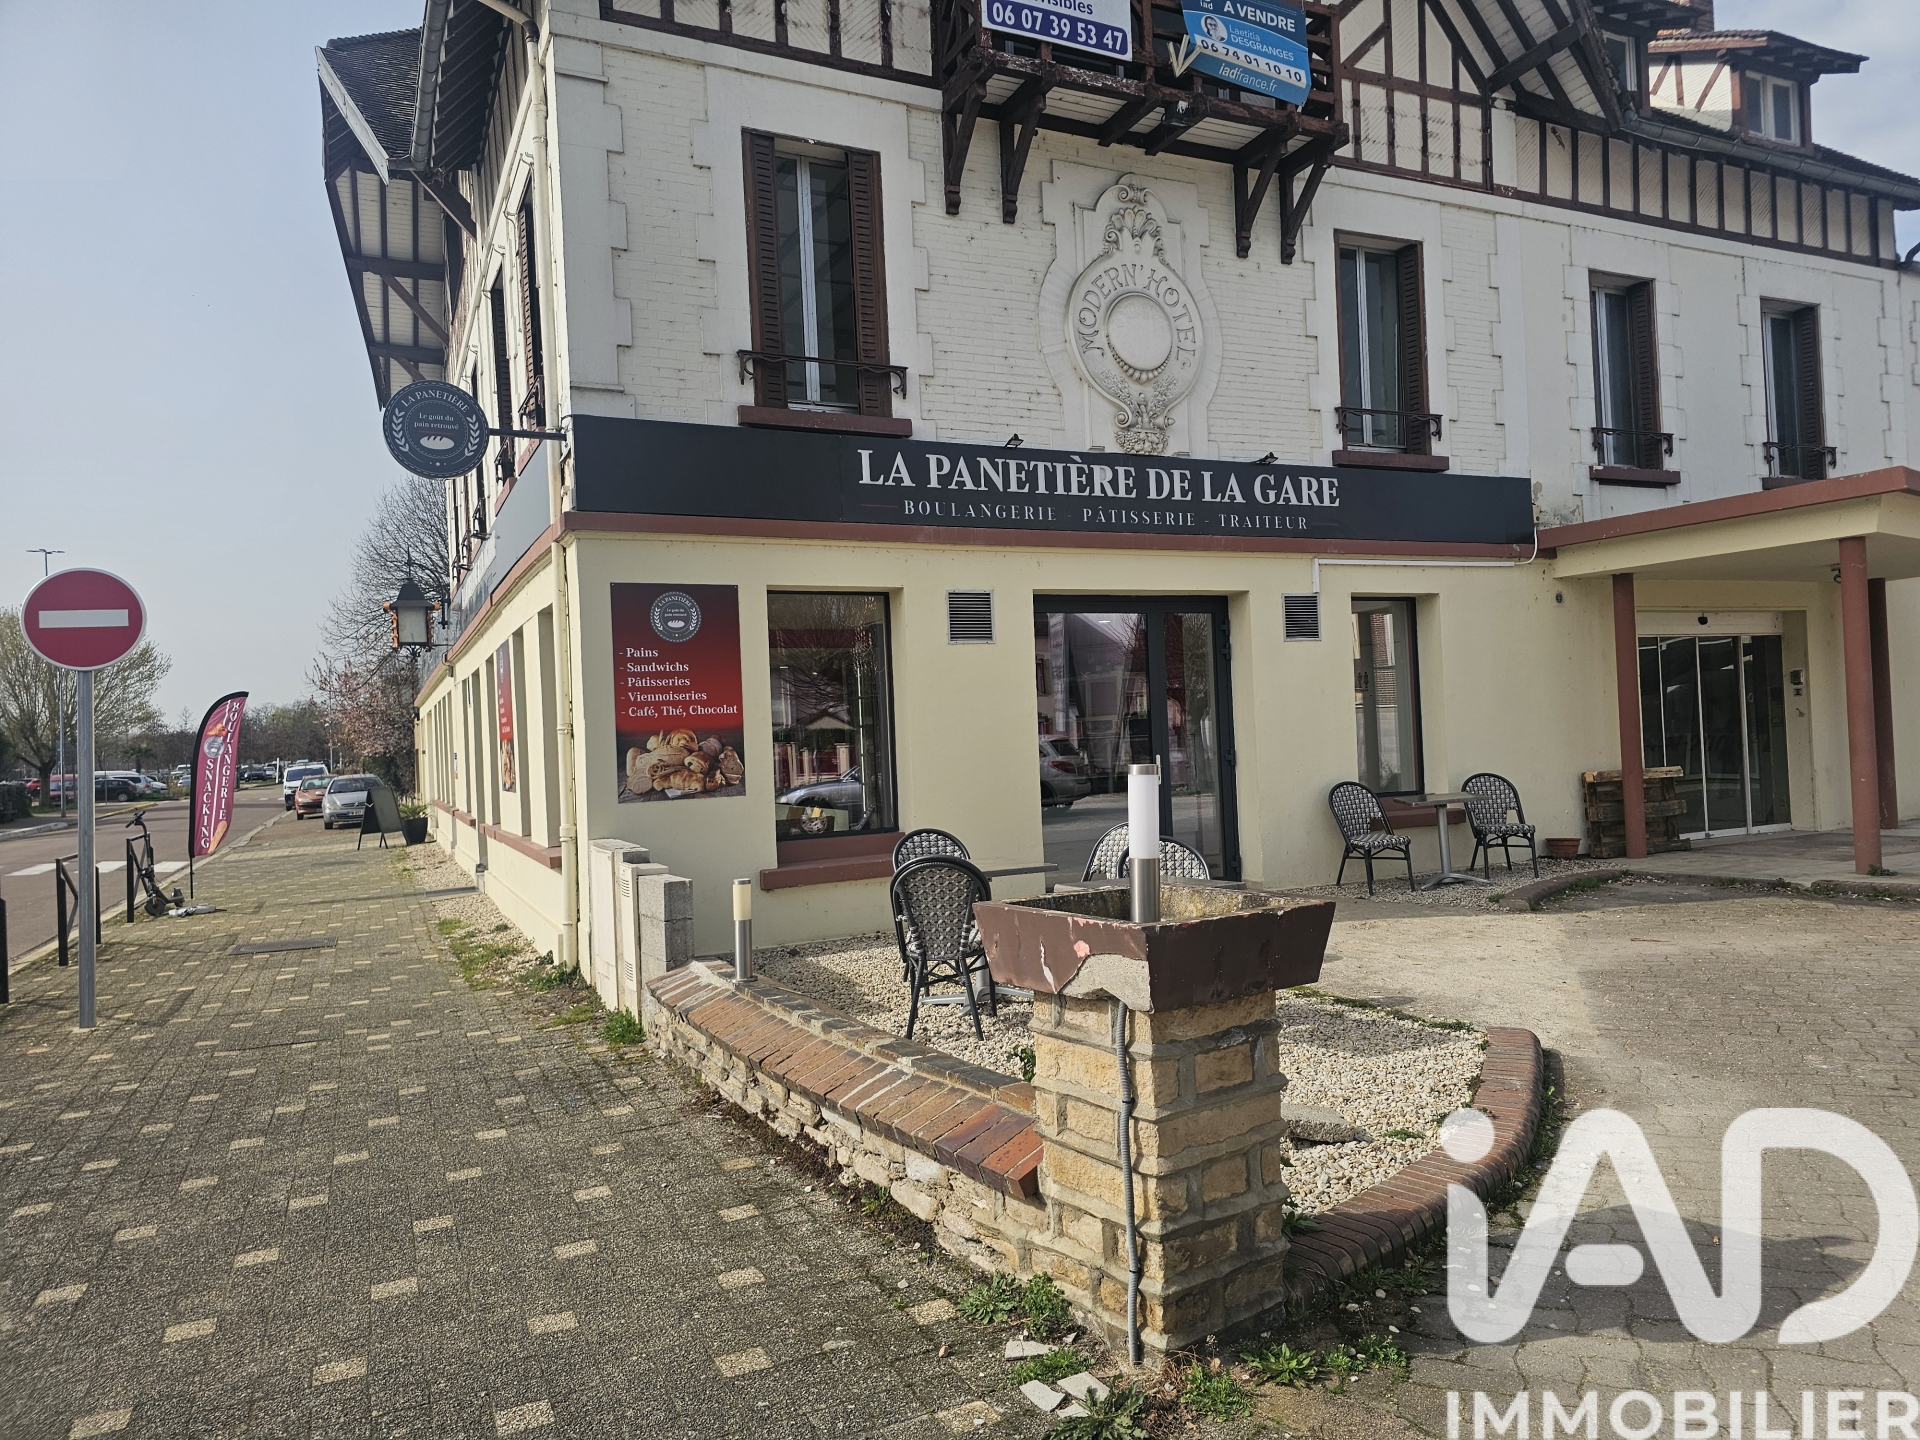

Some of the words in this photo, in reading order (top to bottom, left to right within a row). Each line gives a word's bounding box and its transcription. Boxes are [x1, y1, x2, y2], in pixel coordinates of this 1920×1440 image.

[992, 2, 1015, 25] 06
[1021, 8, 1043, 31] 07
[1049, 15, 1071, 39] 39
[1077, 22, 1097, 45] 53
[1103, 29, 1123, 51] 47
[1236, 3, 1296, 32] VENDRE
[1229, 24, 1260, 41] Laetitia
[1230, 34, 1294, 61] DESGRANGES
[1201, 39, 1219, 53] 06
[1222, 46, 1241, 61] 74
[1244, 54, 1260, 68] 01
[1265, 62, 1282, 75] 10
[1286, 69, 1302, 82] 10
[1219, 63, 1277, 93] iadfrance.fr
[401, 395, 416, 407] LA
[415, 389, 470, 413] PANETIÈRE
[428, 413, 444, 421] goût
[430, 422, 459, 430] retrouvé
[857, 449, 916, 487] LA
[925, 454, 1137, 499] PANETIÈRE
[1146, 467, 1192, 501] DE
[1201, 470, 1246, 504] LA
[1253, 474, 1340, 507] GARE
[903, 499, 1057, 521] BOULANGERIE
[1082, 506, 1195, 527] PÂTISSERIE
[1219, 513, 1308, 530] TRAITEUR
[626, 647, 659, 658] Pains
[627, 662, 689, 672] Sandwichs
[627, 676, 691, 687] Pâtisseries
[628, 690, 708, 702] Viennoiseries
[628, 706, 659, 718] Café,
[661, 705, 687, 717] Thé,
[689, 704, 738, 715] Chocolat
[219, 702, 240, 820] BOULANGERIE
[200, 758, 214, 849] SNACKING
